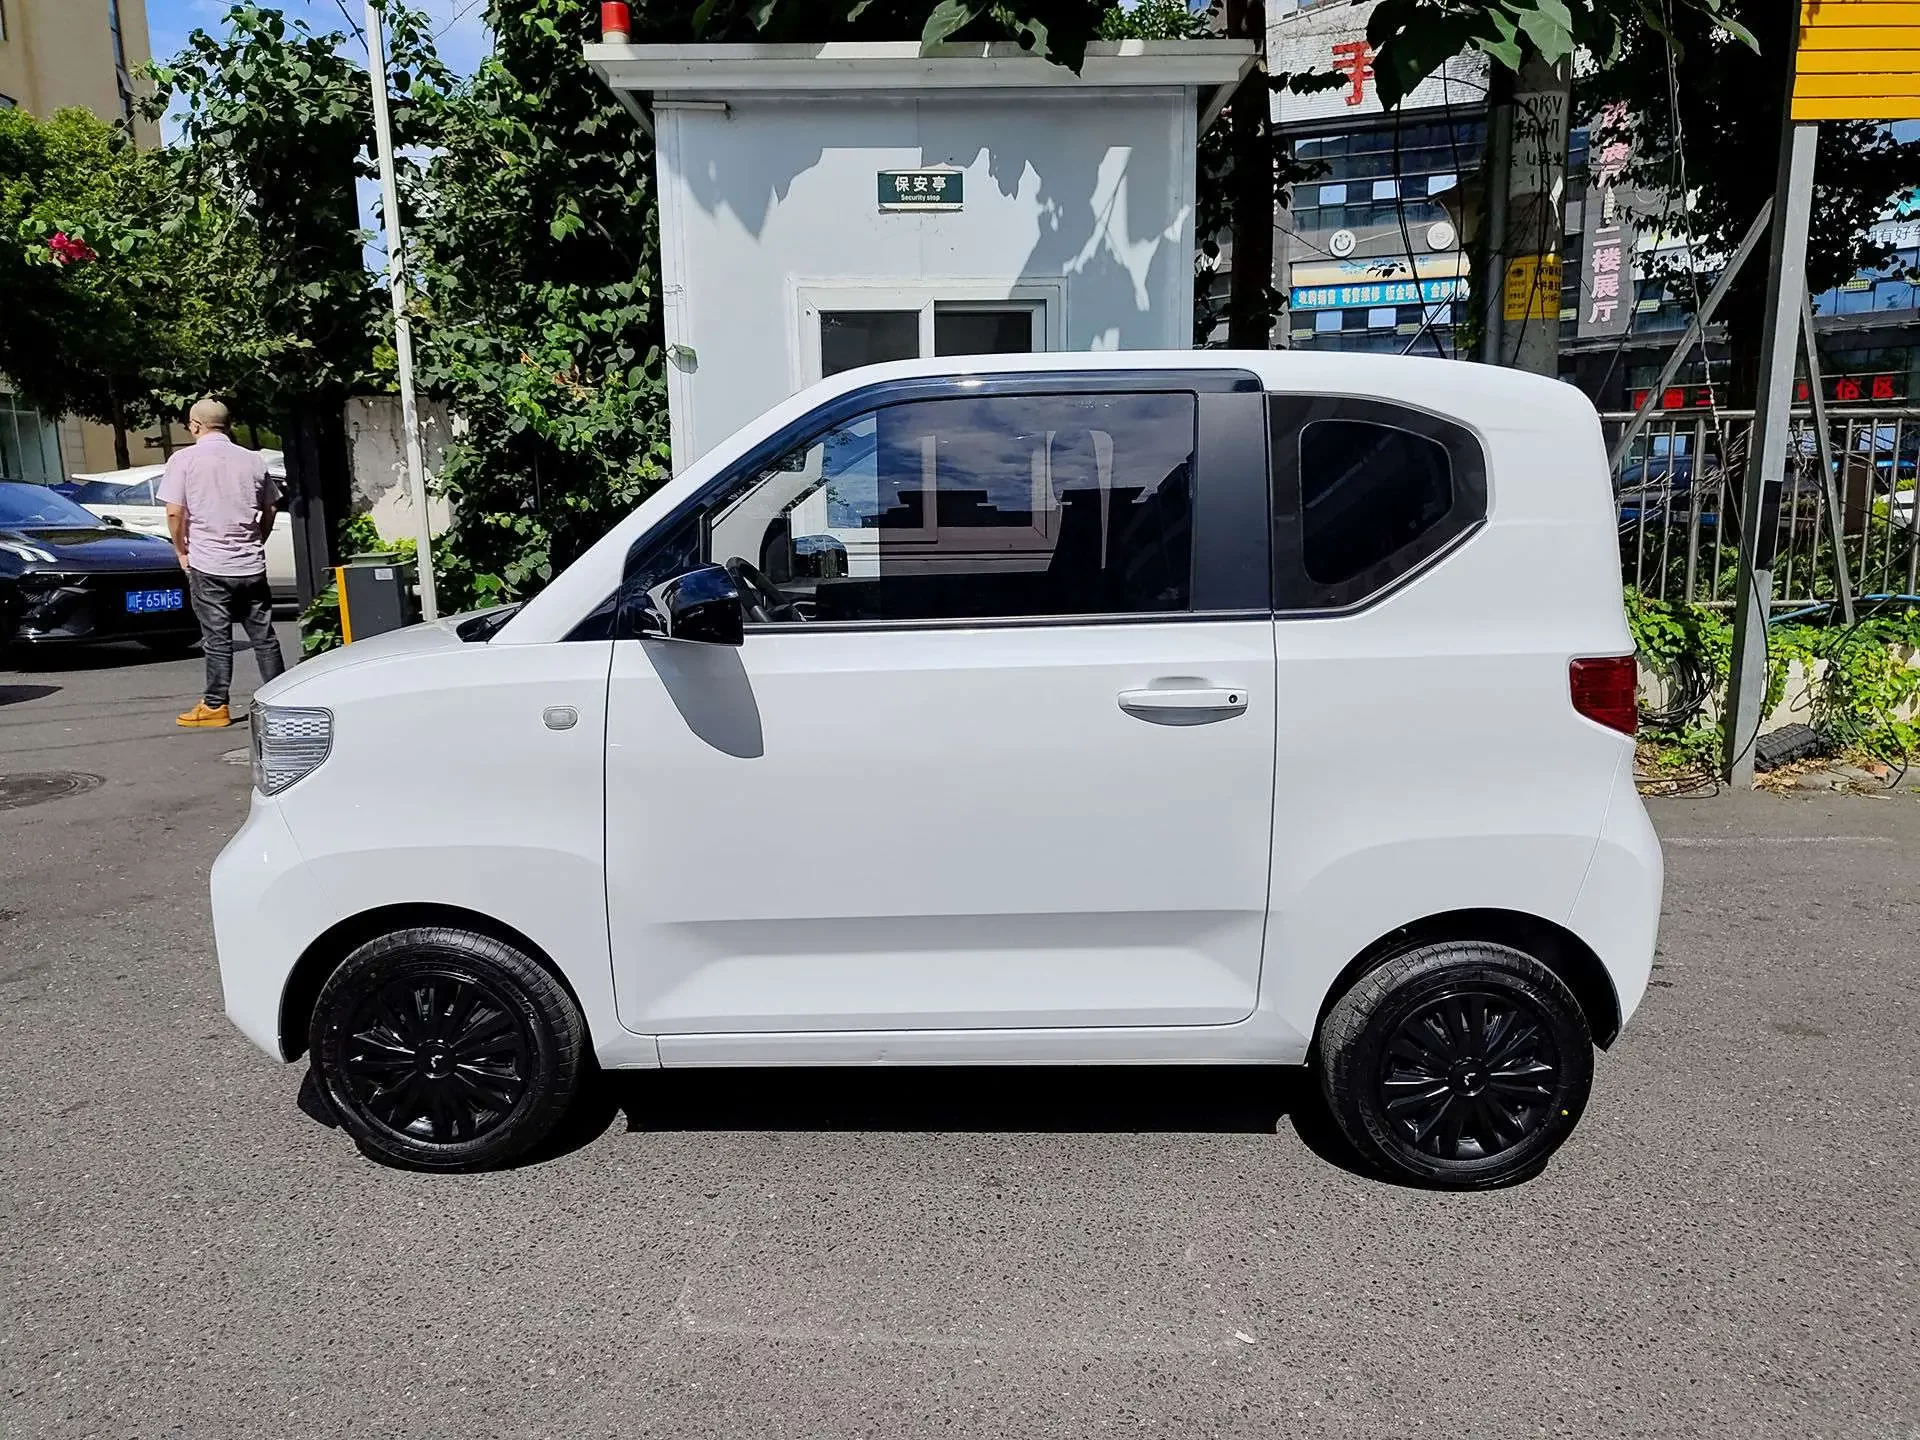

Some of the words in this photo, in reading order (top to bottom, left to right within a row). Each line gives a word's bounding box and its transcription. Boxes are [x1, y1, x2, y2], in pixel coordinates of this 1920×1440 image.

[894, 175, 947, 192] 保安亭
[901, 193, 926, 202] Security
[926, 193, 941, 202] stop
[1588, 225, 1621, 324] 二楼展厅
